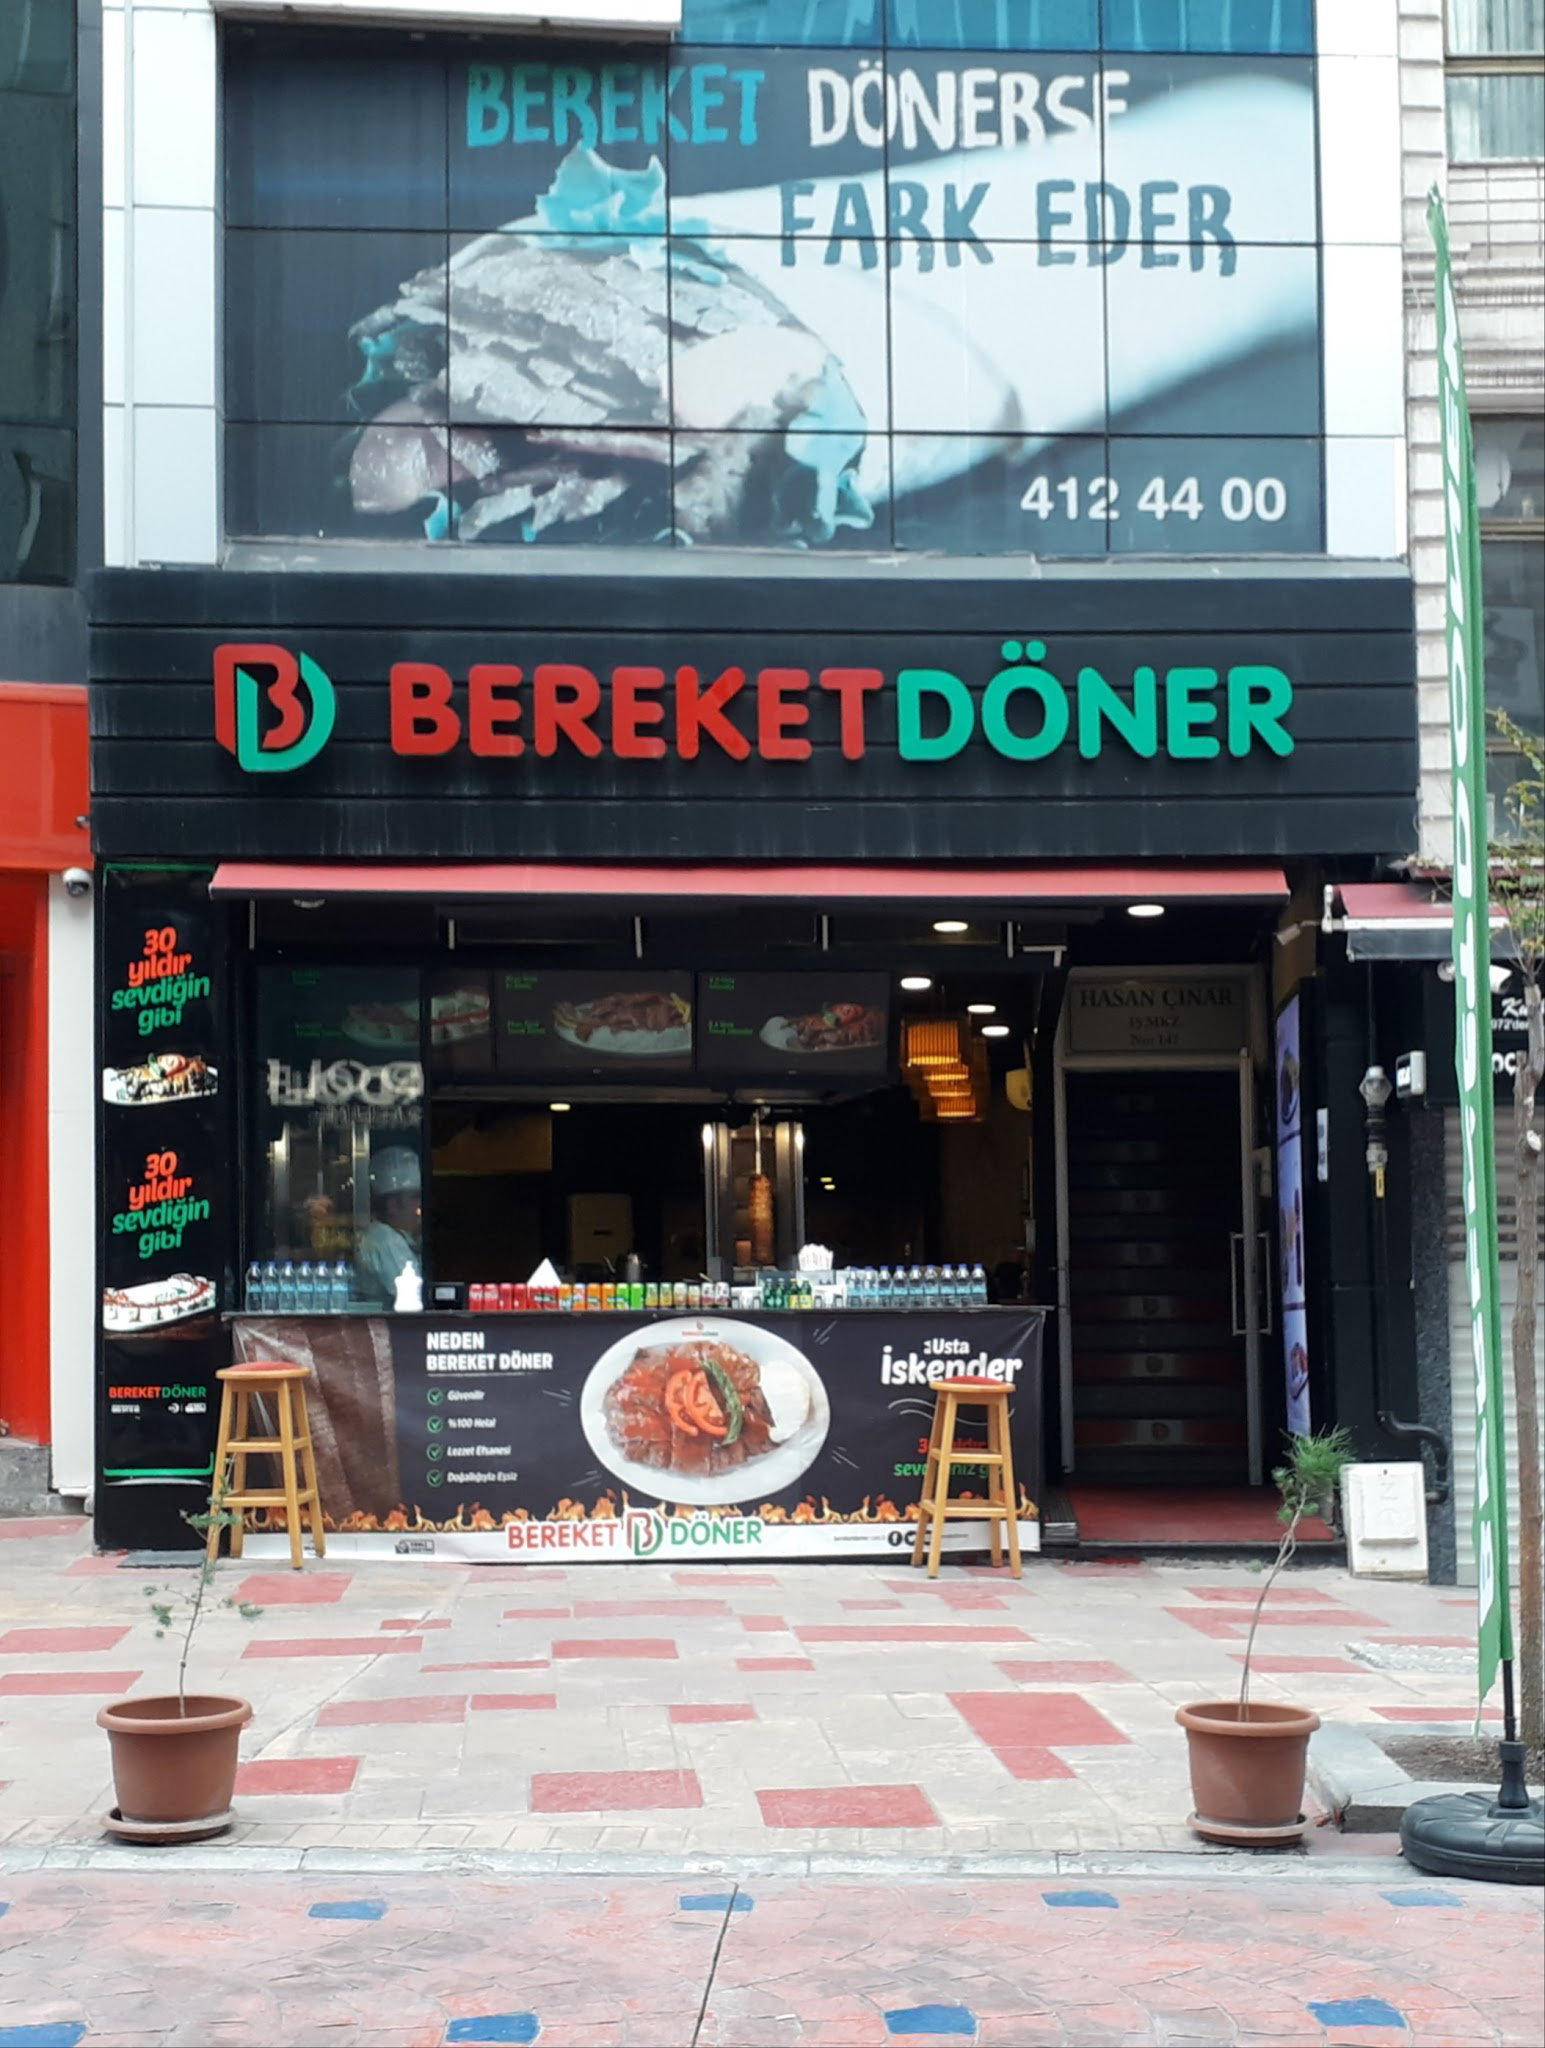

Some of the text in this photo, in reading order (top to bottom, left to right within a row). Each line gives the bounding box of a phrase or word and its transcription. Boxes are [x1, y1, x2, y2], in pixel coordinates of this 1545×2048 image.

[466, 63, 766, 148] BEREKET
[779, 179, 1237, 277] FARK EDER
[1020, 476, 1287, 521] 412 44 00
[389, 640, 1295, 761] BEREKET DÖNER
[143, 926, 177, 956] 30
[128, 952, 192, 988] yıldır
[111, 972, 210, 1010] sevdiğin
[1080, 989, 1155, 1007] HASAN
[138, 1005, 182, 1036] gibi
[144, 1150, 178, 1180] 30
[129, 1175, 193, 1212] yıldır
[112, 1196, 210, 1234] sevdiğin
[138, 1230, 182, 1259] gibi
[426, 1331, 485, 1350] NEDEN
[932, 1338, 970, 1355] Usta
[426, 1350, 553, 1371] BEREKET DÖNER
[881, 1345, 1023, 1385] İskender
[108, 1384, 207, 1399] BEREKET DÖNER
[448, 1417, 473, 1429] %100
[447, 1446, 475, 1457] Lezzet
[508, 1522, 619, 1549] BEREKET
[670, 1514, 763, 1545] DÖNER
